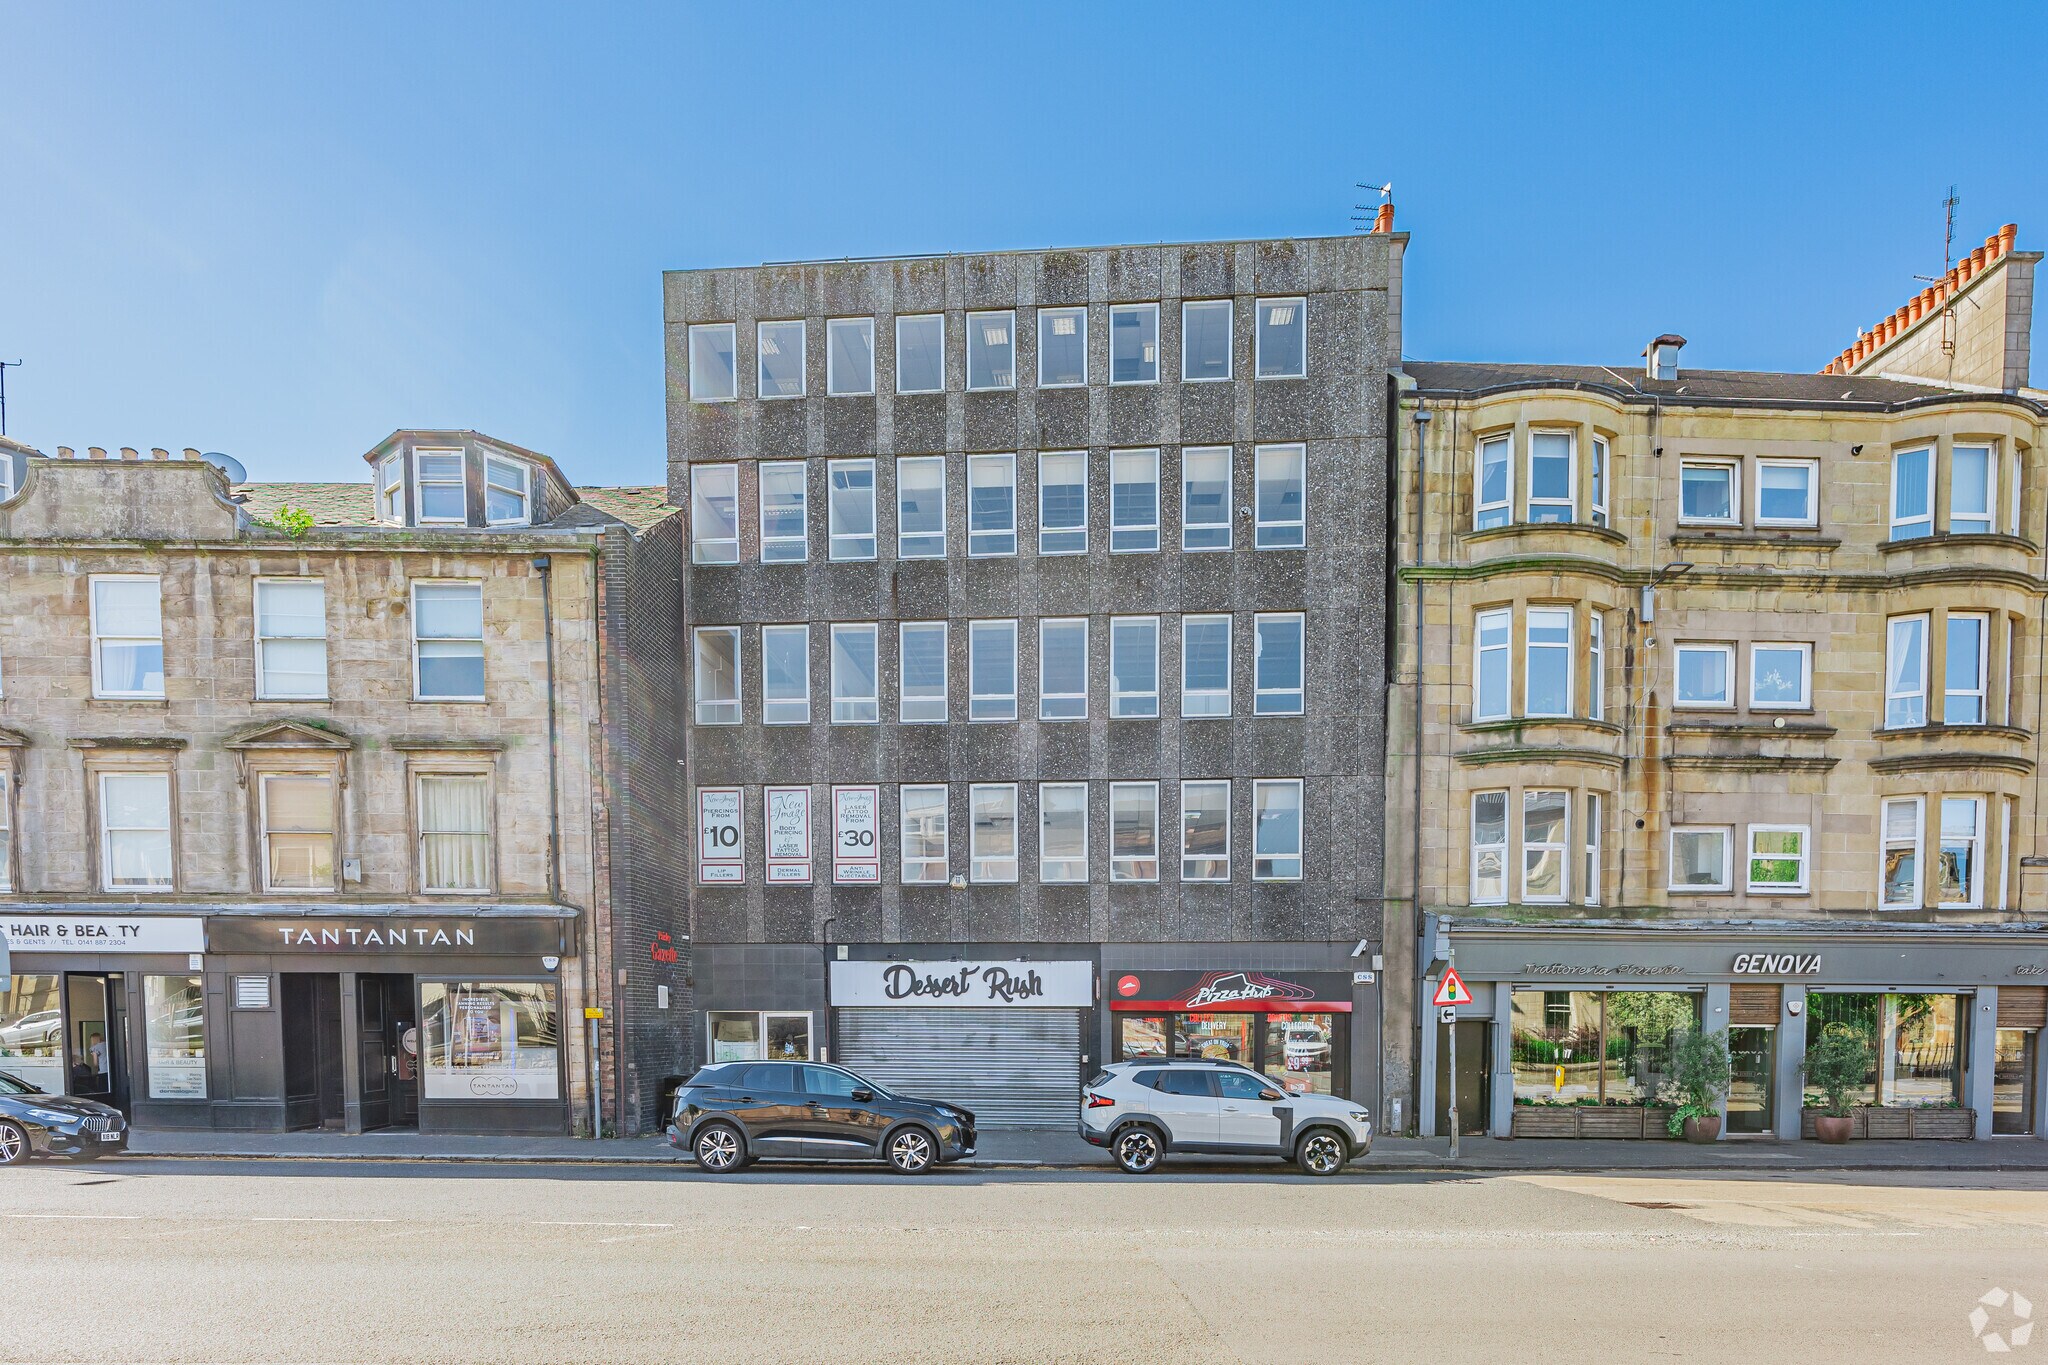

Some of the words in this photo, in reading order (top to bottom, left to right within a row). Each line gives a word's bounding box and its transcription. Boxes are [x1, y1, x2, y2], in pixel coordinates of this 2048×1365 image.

[771, 793, 803, 811] New
[771, 807, 805, 826] Image
[11, 924, 50, 937] HAIR
[57, 924, 68, 937] &
[75, 925, 140, 938] BEATY
[279, 928, 474, 946] TANTANTAN
[1618, 963, 1684, 976] Pizzeria
[1732, 954, 1822, 974] GENOVA
[2016, 965, 2047, 975] take
[883, 964, 980, 999] Dessert
[983, 966, 1044, 1003] Rush
[1195, 986, 1240, 1004] Pizza
[1241, 983, 1275, 1000] Hut
[1201, 1021, 1227, 1030] DELIVERY
